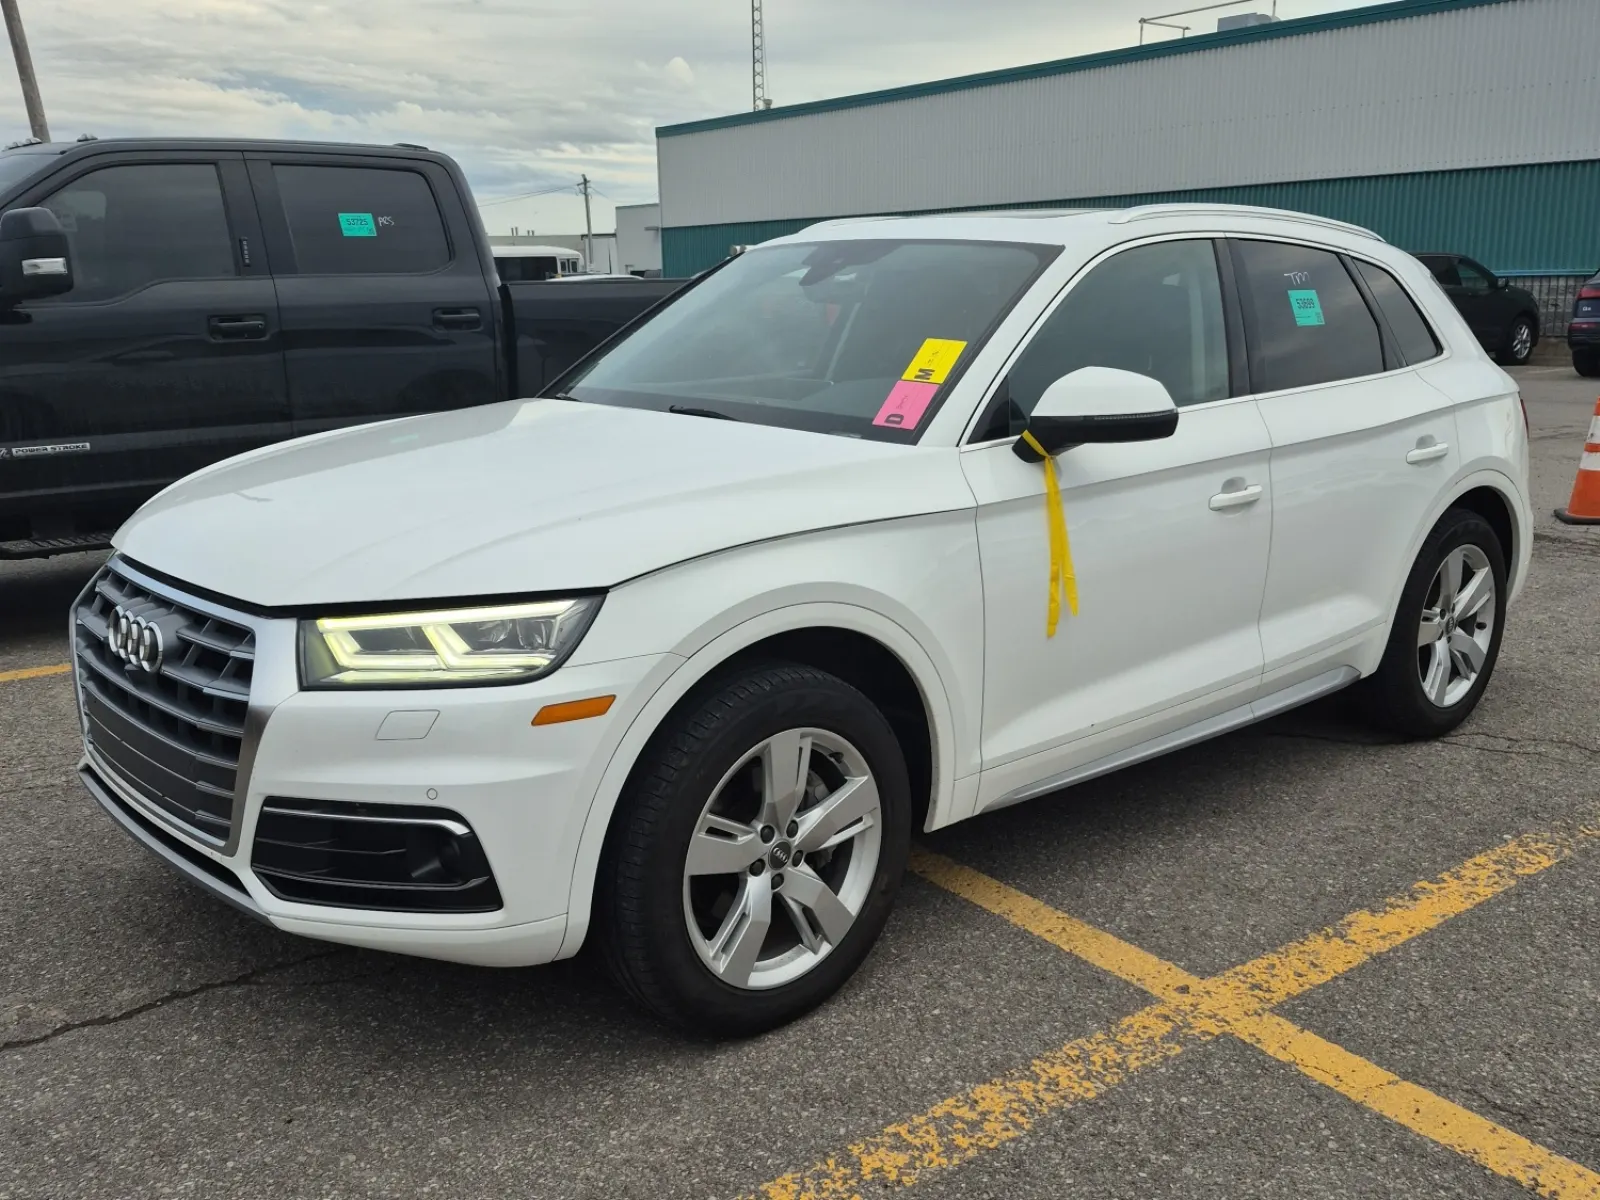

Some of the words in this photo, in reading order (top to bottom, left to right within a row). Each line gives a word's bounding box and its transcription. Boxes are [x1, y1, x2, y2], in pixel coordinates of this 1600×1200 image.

[914, 368, 936, 381] M
[884, 413, 905, 426] D
[15, 446, 49, 454] POWER
[50, 443, 88, 452] STROKE
